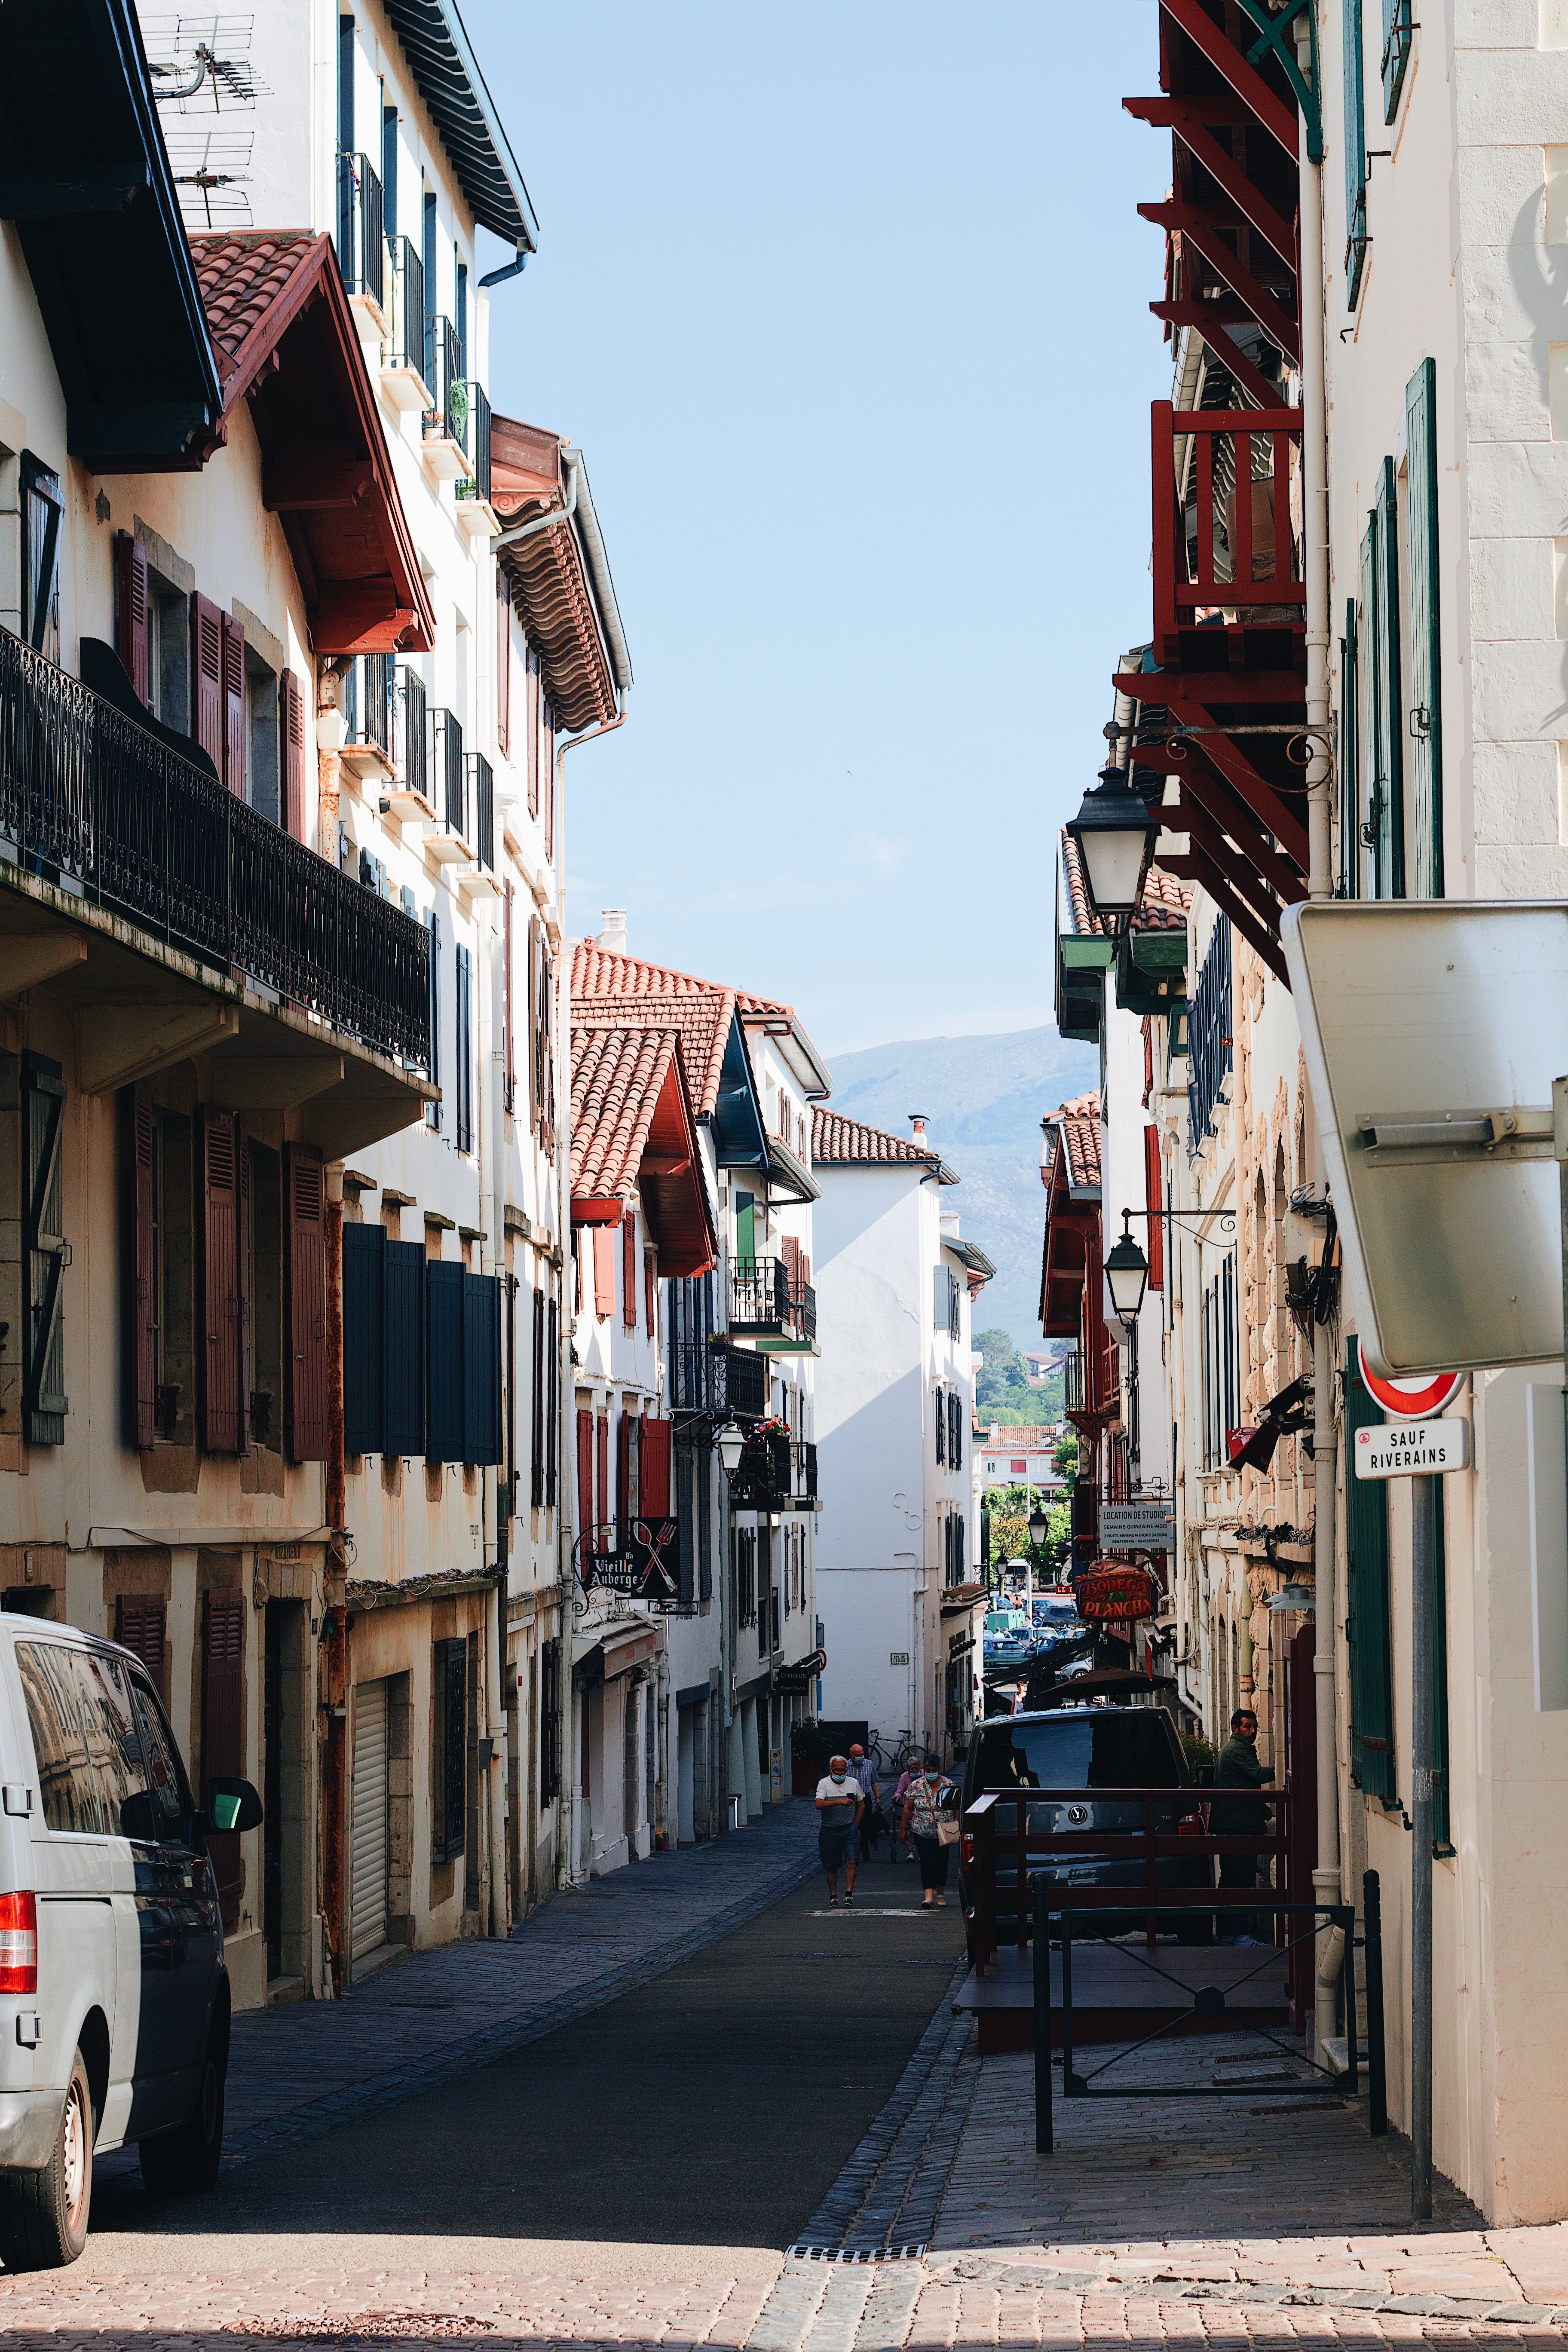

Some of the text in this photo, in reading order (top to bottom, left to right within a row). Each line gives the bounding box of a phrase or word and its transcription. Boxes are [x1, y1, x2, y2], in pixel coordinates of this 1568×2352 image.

[1390, 1430, 1425, 1447] SAUF
[1371, 1448, 1446, 1469] RIVERAINS
[1103, 1510, 1167, 1520] LOCATION DE STUDIOS
[594, 1559, 633, 1573] Vieille
[589, 1571, 638, 1589] Auberge
[1082, 1579, 1148, 1599] BODEGA
[1108, 1592, 1125, 1601] LA
[1082, 1599, 1154, 1617] PLANCHA
